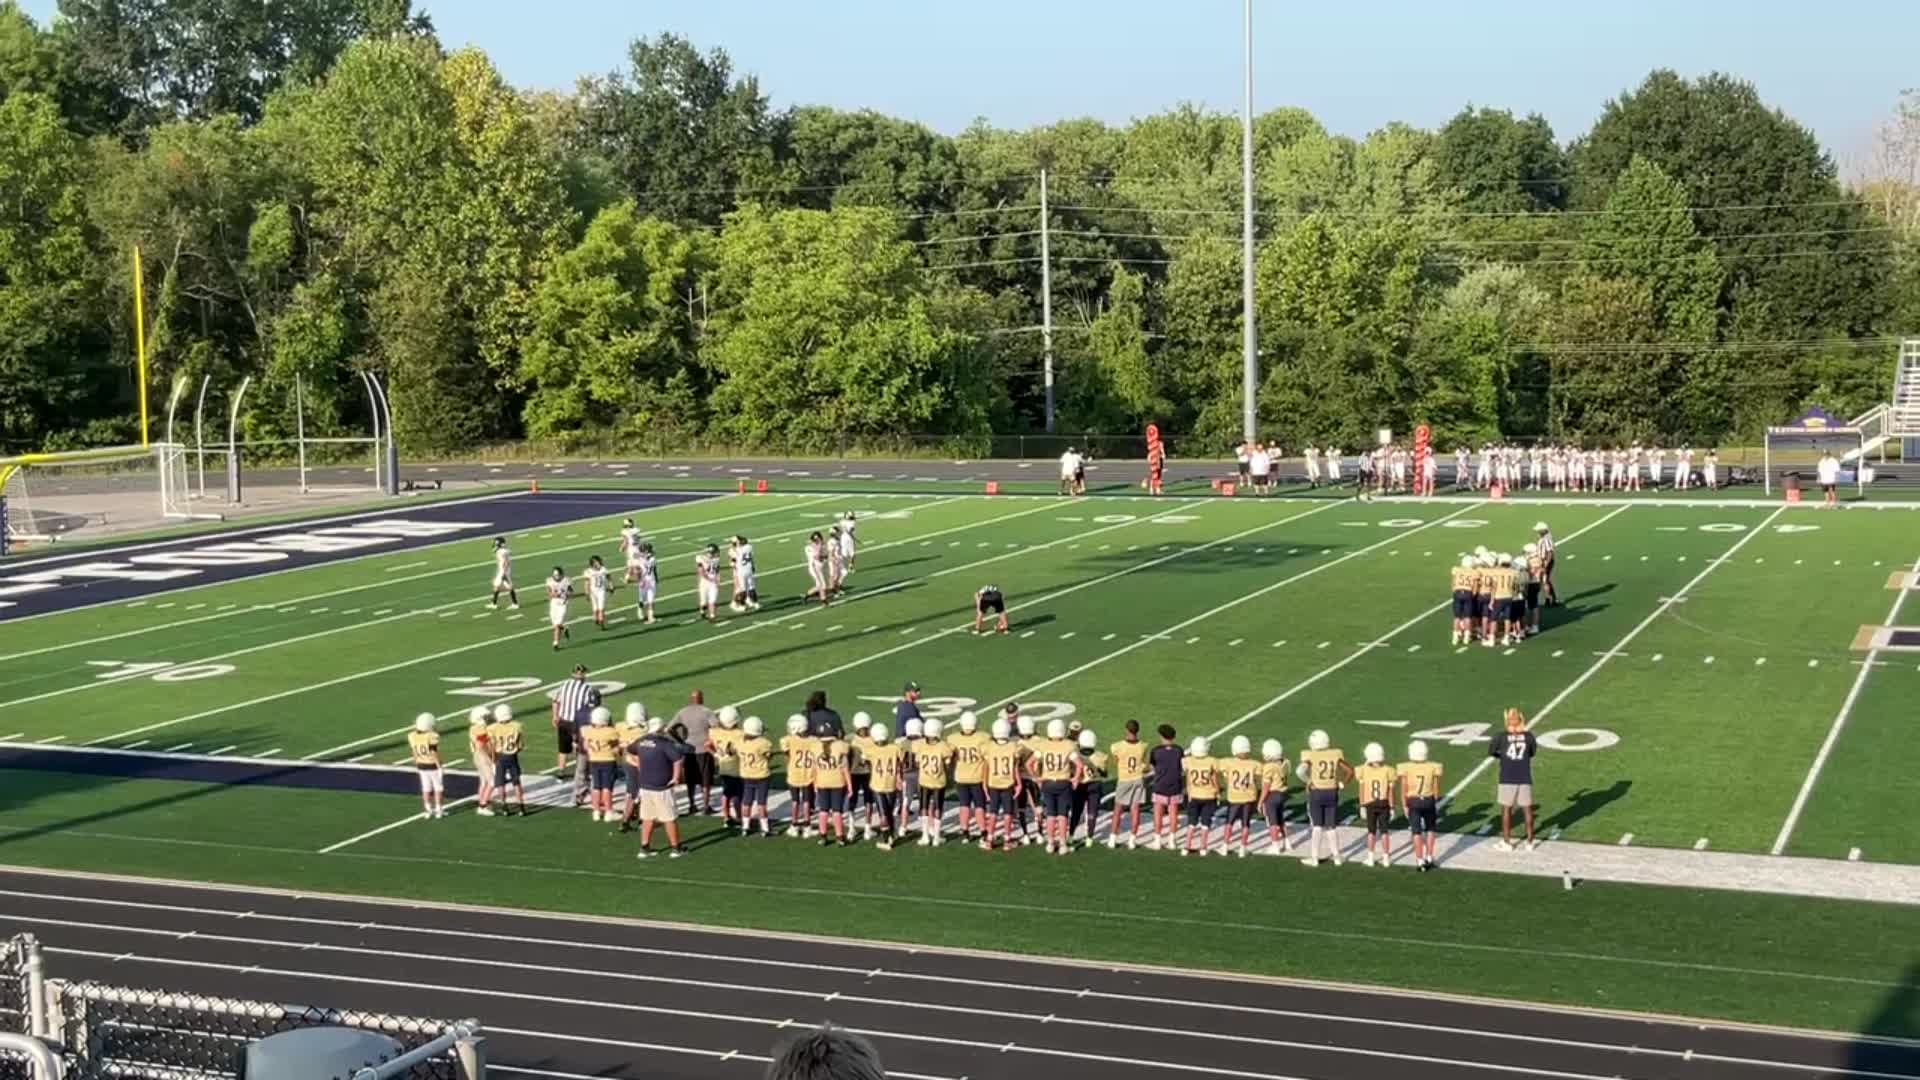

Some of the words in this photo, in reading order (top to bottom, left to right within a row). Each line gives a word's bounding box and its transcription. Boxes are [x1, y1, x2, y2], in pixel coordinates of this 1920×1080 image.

[1410, 721, 1620, 752] 40
[796, 749, 813, 768] 26
[1506, 742, 1527, 760] 47
[875, 758, 894, 777] 44
[922, 754, 939, 775] 23
[993, 756, 1010, 775] 13
[1046, 752, 1063, 771] 81
[1127, 756, 1137, 774] 9
[1319, 760, 1335, 780] 21
[1190, 769, 1210, 786] 25
[1232, 770, 1251, 789] 24
[1416, 775, 1425, 795] 7
[1371, 779, 1381, 800] 8
